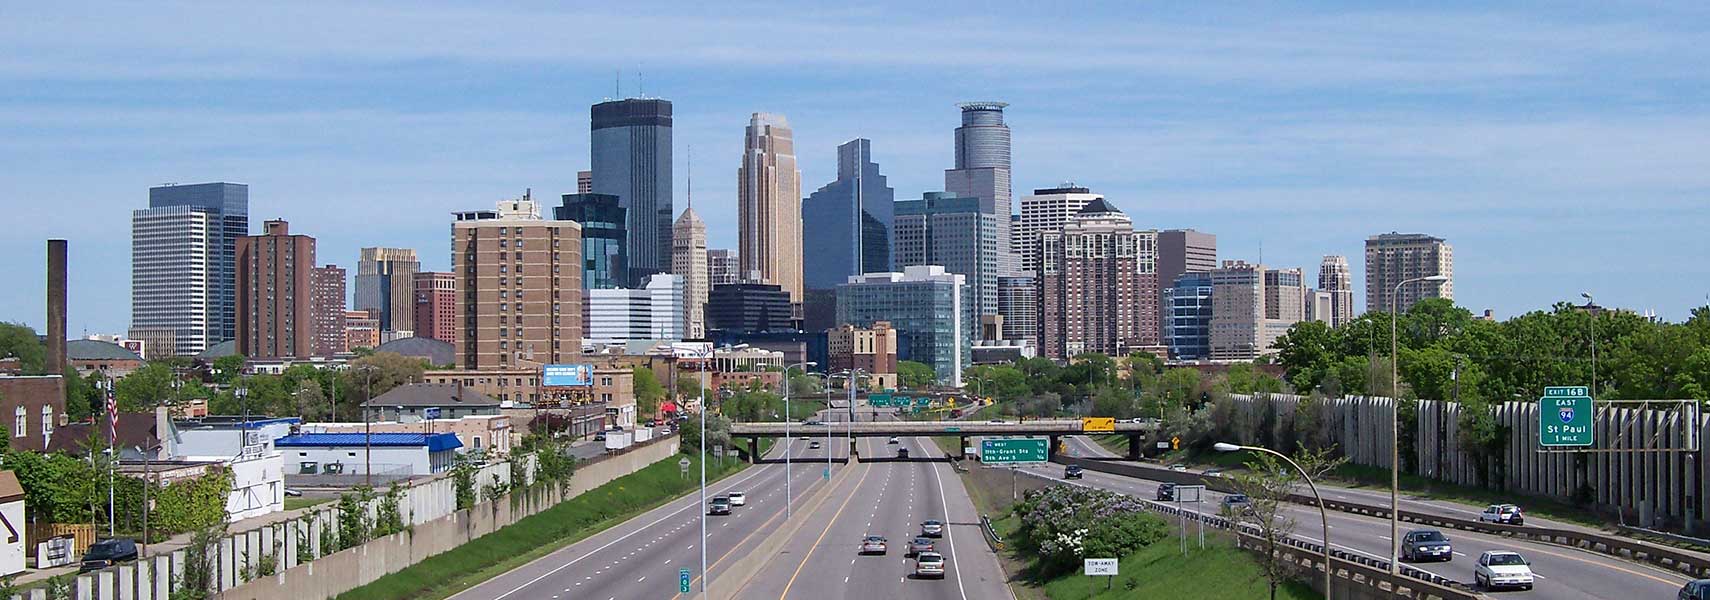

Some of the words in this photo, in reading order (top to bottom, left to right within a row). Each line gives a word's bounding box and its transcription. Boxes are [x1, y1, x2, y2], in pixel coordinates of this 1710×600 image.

[1561, 411, 1572, 419] 94
[1548, 425, 1558, 433] St
[1563, 425, 1586, 433] Paul
